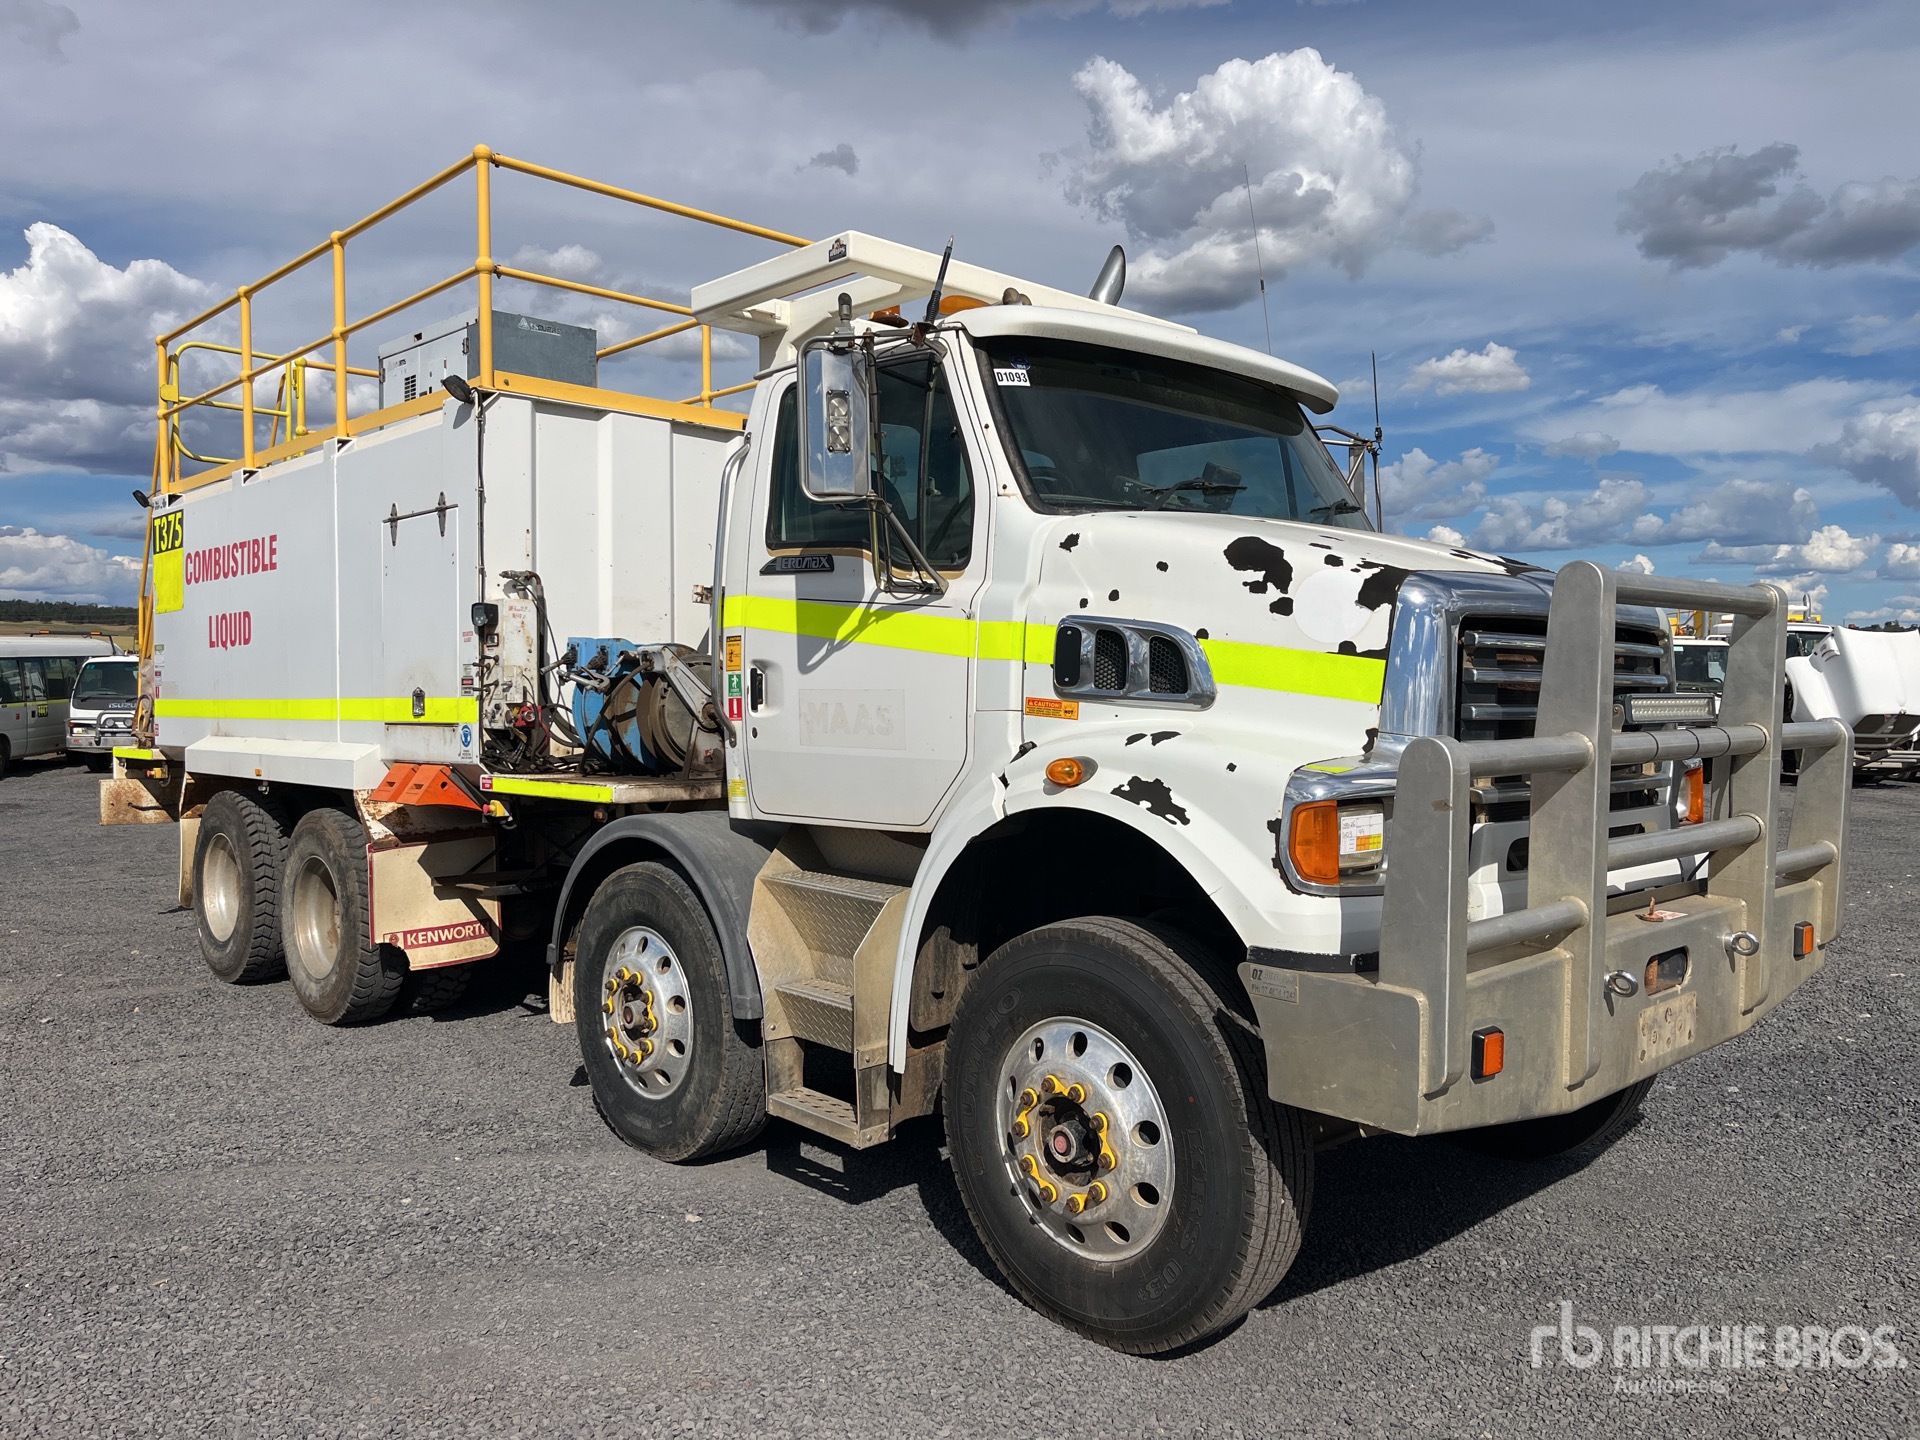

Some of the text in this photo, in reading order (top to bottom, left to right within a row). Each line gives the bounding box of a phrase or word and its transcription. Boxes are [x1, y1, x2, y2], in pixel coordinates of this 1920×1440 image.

[996, 371, 1028, 383] D1093
[153, 511, 183, 553] T375
[185, 534, 278, 586] COMBUSTIBLE
[208, 611, 252, 652] LIQUID
[804, 702, 895, 736] MAAS
[1033, 700, 1062, 708] CAUTION
